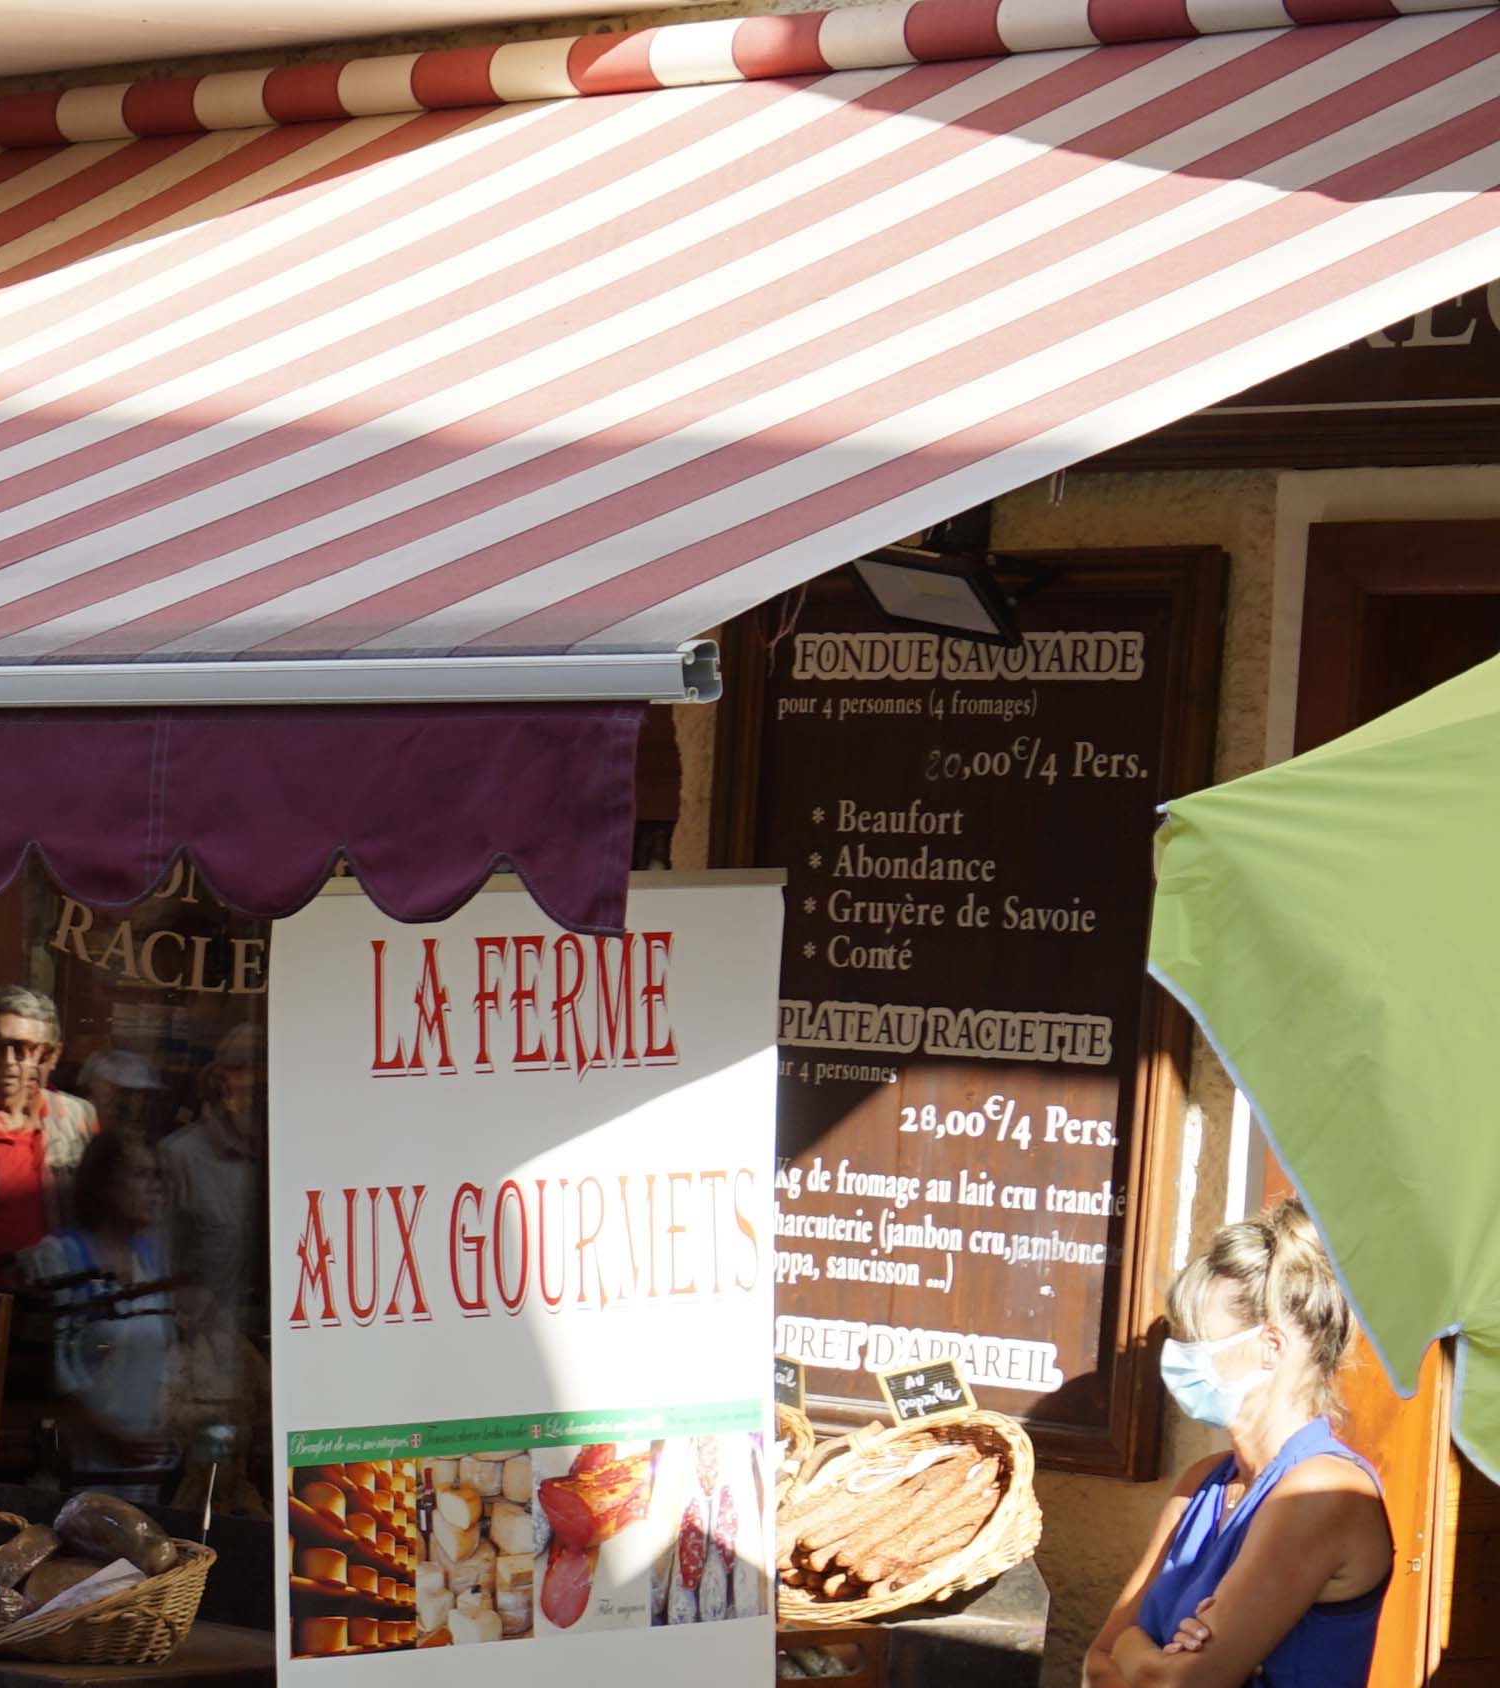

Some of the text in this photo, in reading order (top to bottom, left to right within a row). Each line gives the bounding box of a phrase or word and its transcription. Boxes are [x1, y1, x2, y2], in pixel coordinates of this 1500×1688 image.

[798, 637, 1143, 674] FONDUE SAVOYARDE
[778, 688, 1038, 721] pour 4 personnes (4 fromages)
[1073, 741, 1149, 779] Pers.
[836, 799, 964, 836] Beaufort
[832, 843, 997, 883] Abondance
[827, 888, 1097, 935] Gruyère de Savoie
[49, 894, 269, 995] RACLE
[827, 935, 913, 971] Comté
[370, 931, 680, 1082] LA FERME
[779, 1008, 1108, 1058] PLATEAU RACLETTE
[779, 1060, 899, 1085] ur 4 personnes
[1044, 1105, 1120, 1147] Pers.
[775, 1155, 1126, 1218] Kg de fromage au lait cru tranché
[289, 1167, 760, 1330] AUX GOURMETS
[774, 1202, 963, 1255] harcuterie (jambon
[827, 1248, 920, 1287] saucisson
[782, 1322, 1055, 1385] PRET D'APPAREIL
